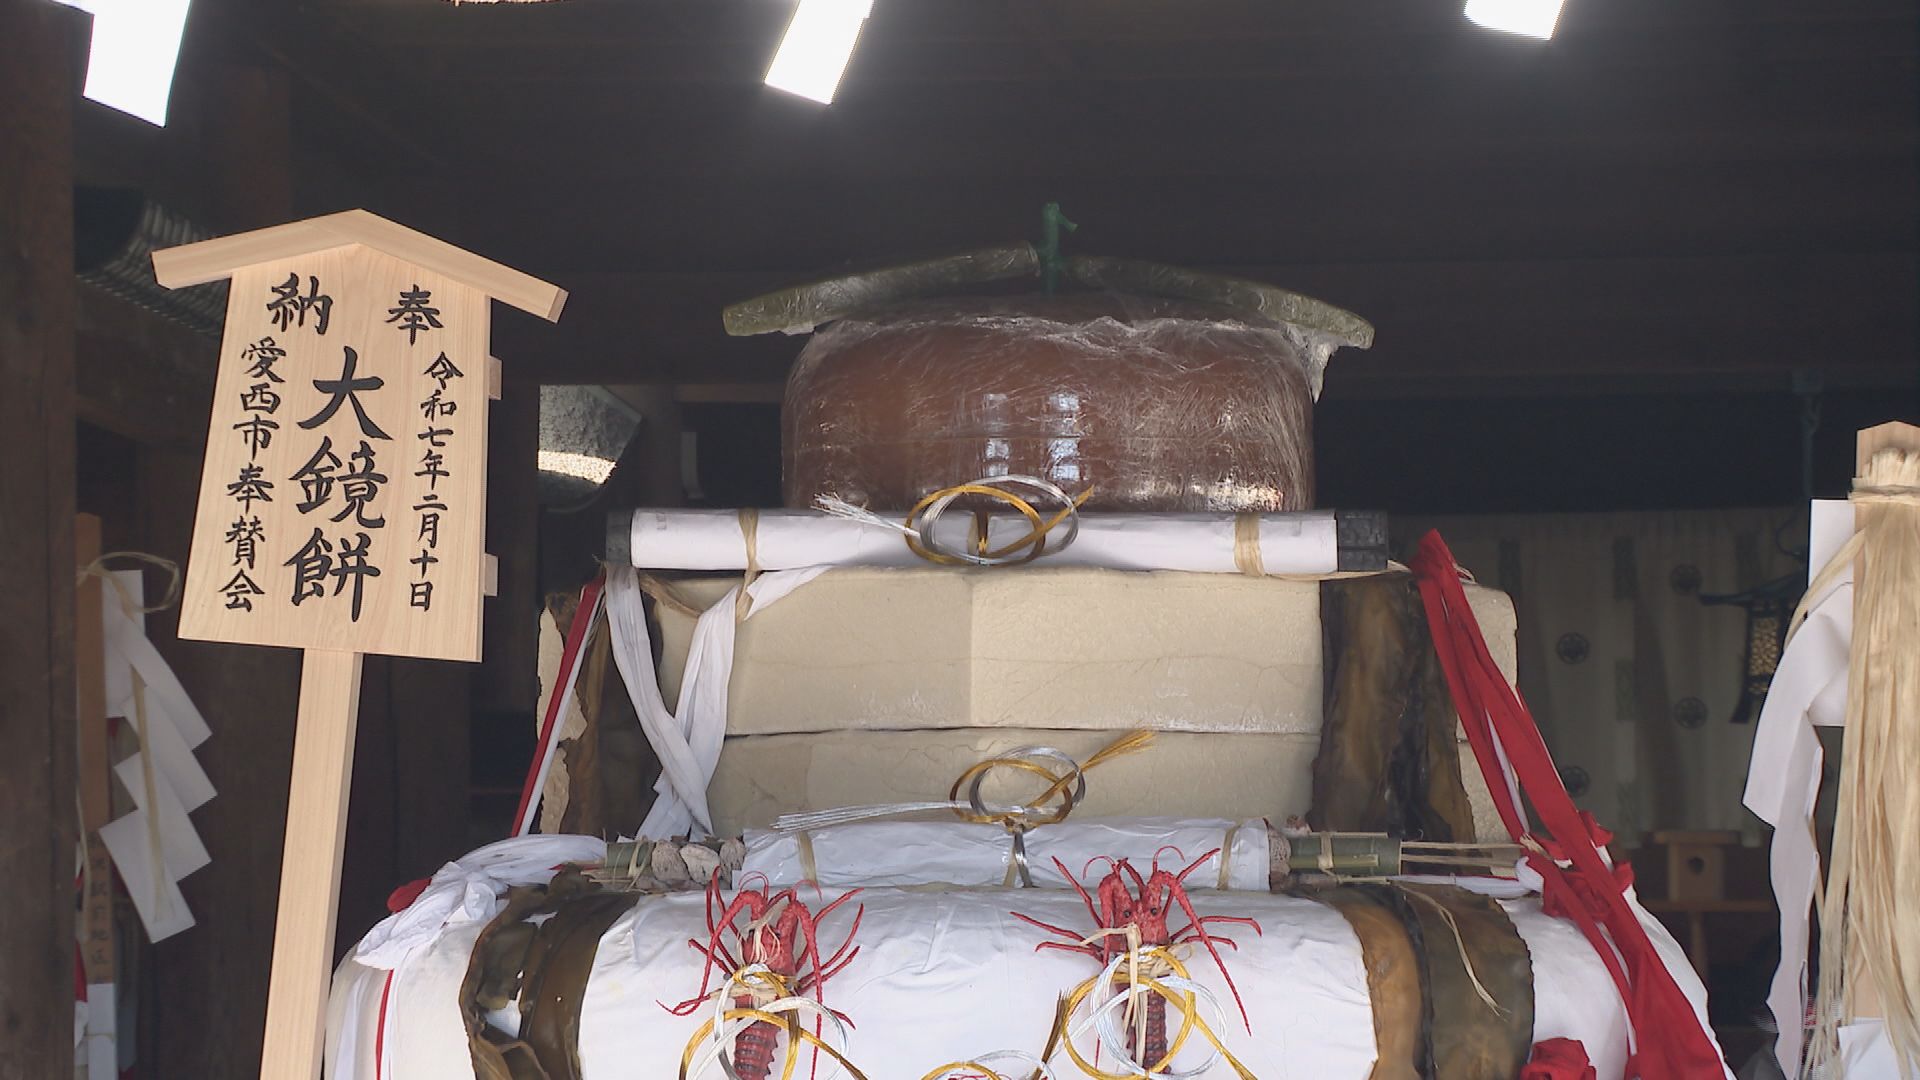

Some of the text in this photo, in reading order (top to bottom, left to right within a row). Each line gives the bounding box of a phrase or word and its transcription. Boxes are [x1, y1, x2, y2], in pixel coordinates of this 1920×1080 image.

[267, 272, 444, 346] 奉 納
[218, 336, 287, 612] 愛西市奉賛会
[282, 346, 393, 622] 大鏡餅
[410, 351, 464, 612] 令和七年二月十日
